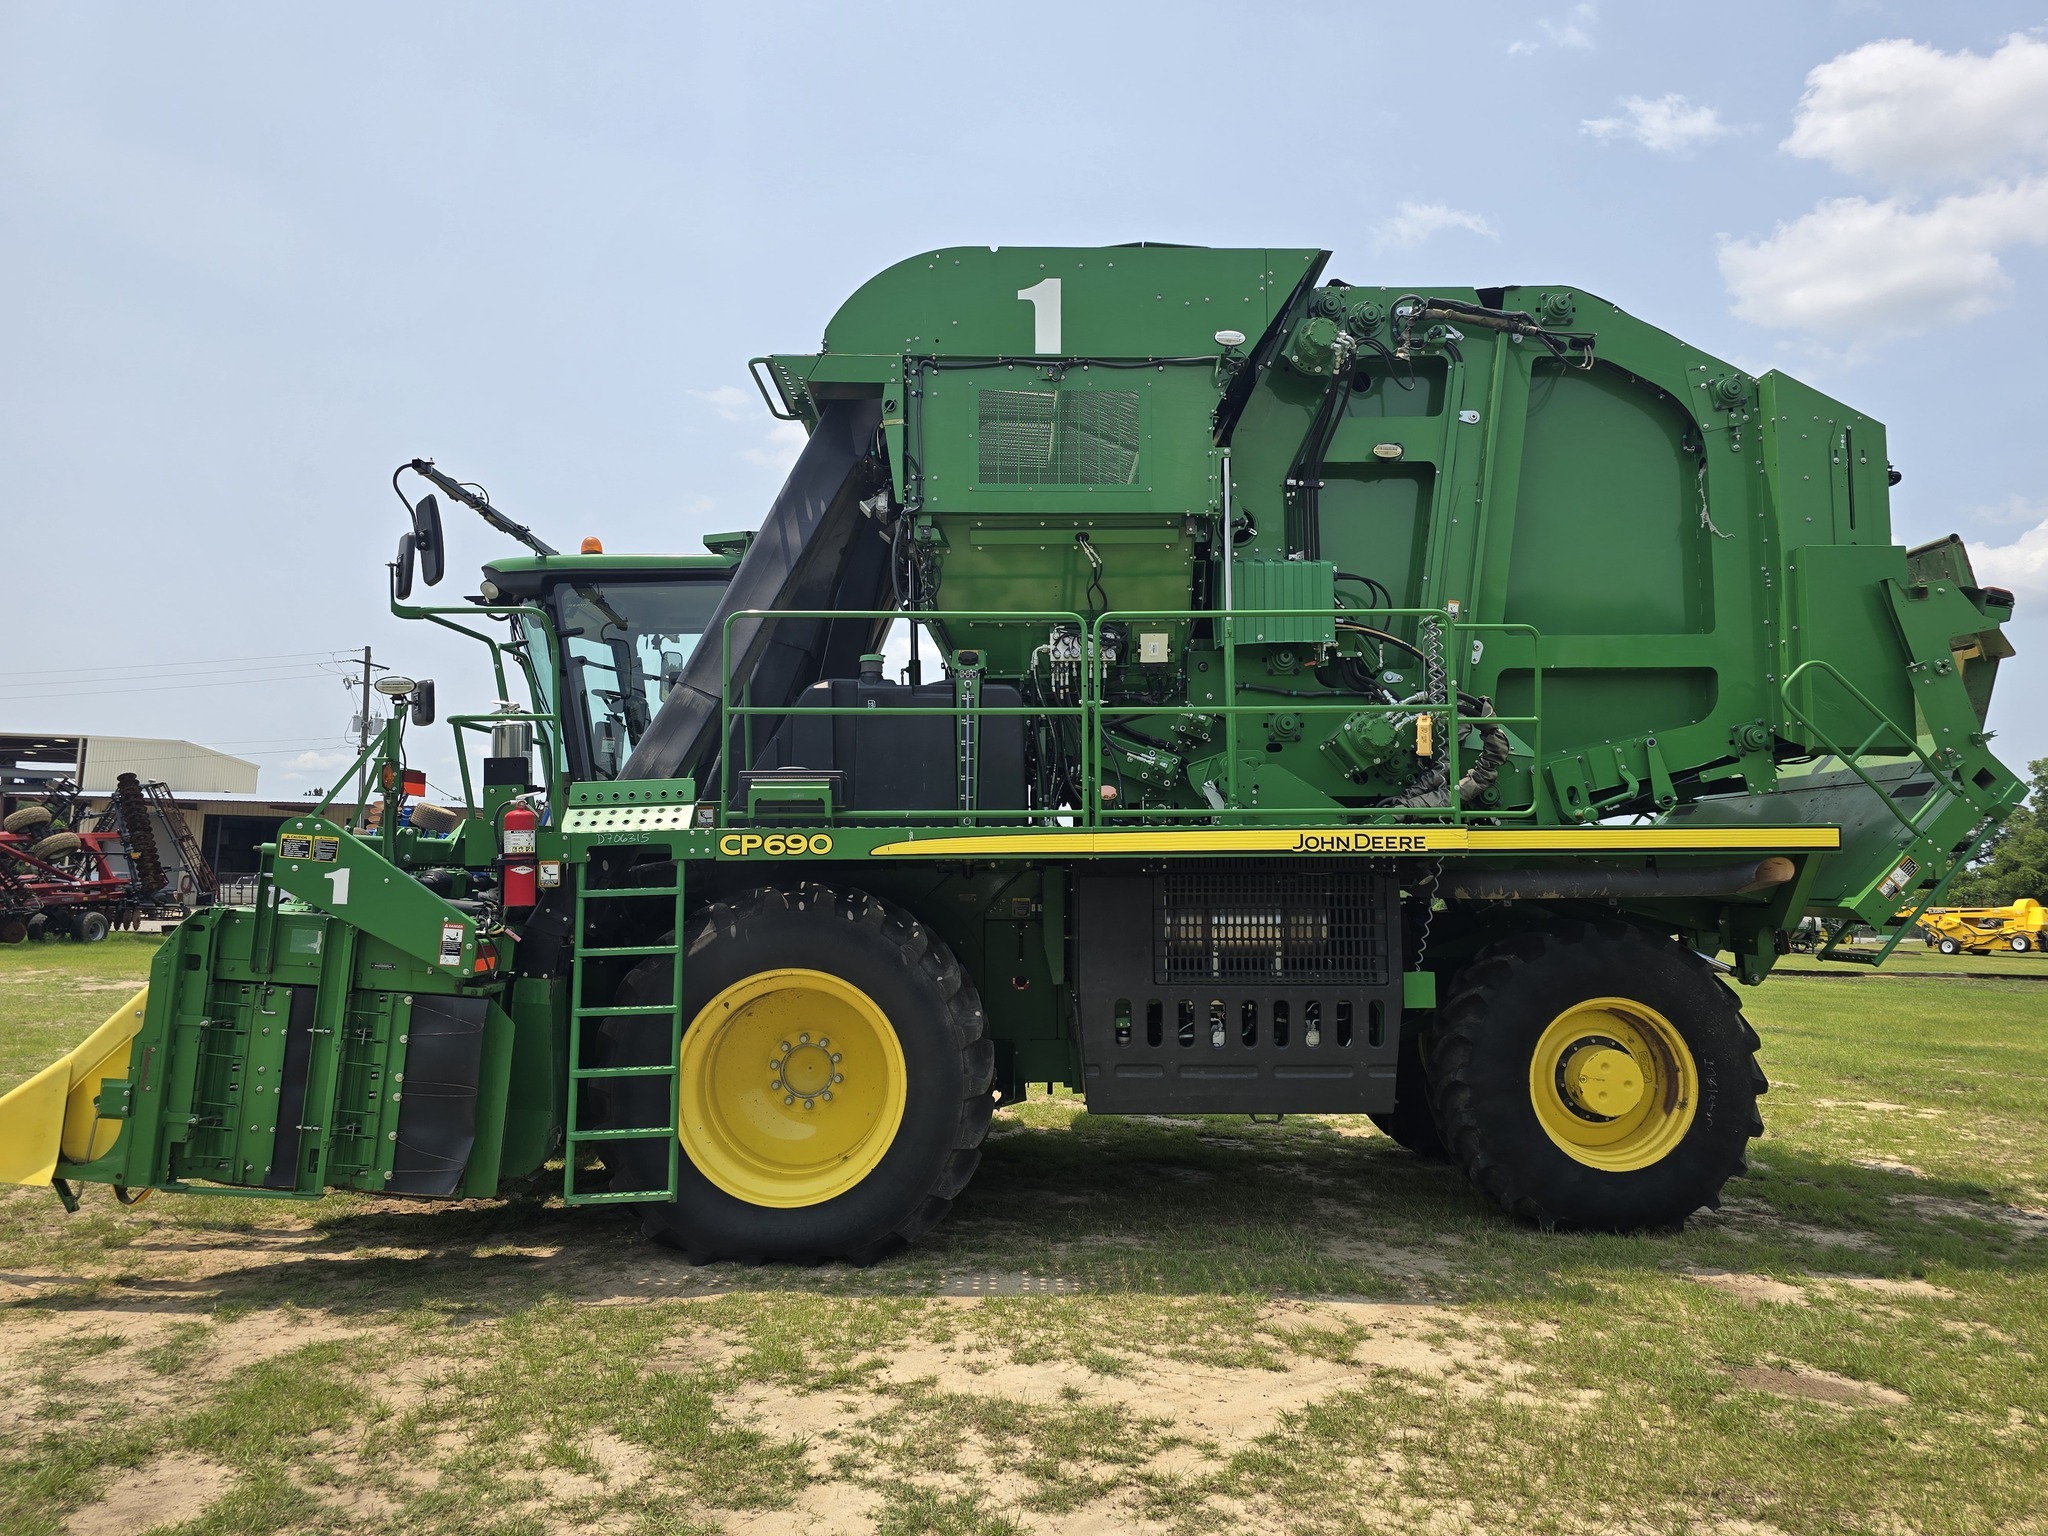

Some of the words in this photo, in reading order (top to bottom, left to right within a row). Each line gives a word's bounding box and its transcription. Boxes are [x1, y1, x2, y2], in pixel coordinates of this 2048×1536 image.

[1017, 278, 1062, 355] 1
[596, 832, 651, 845] D706315
[719, 833, 834, 856] CP690
[1292, 833, 1350, 850] JOHN
[1354, 833, 1427, 850] DEERE
[324, 867, 350, 905] 1
